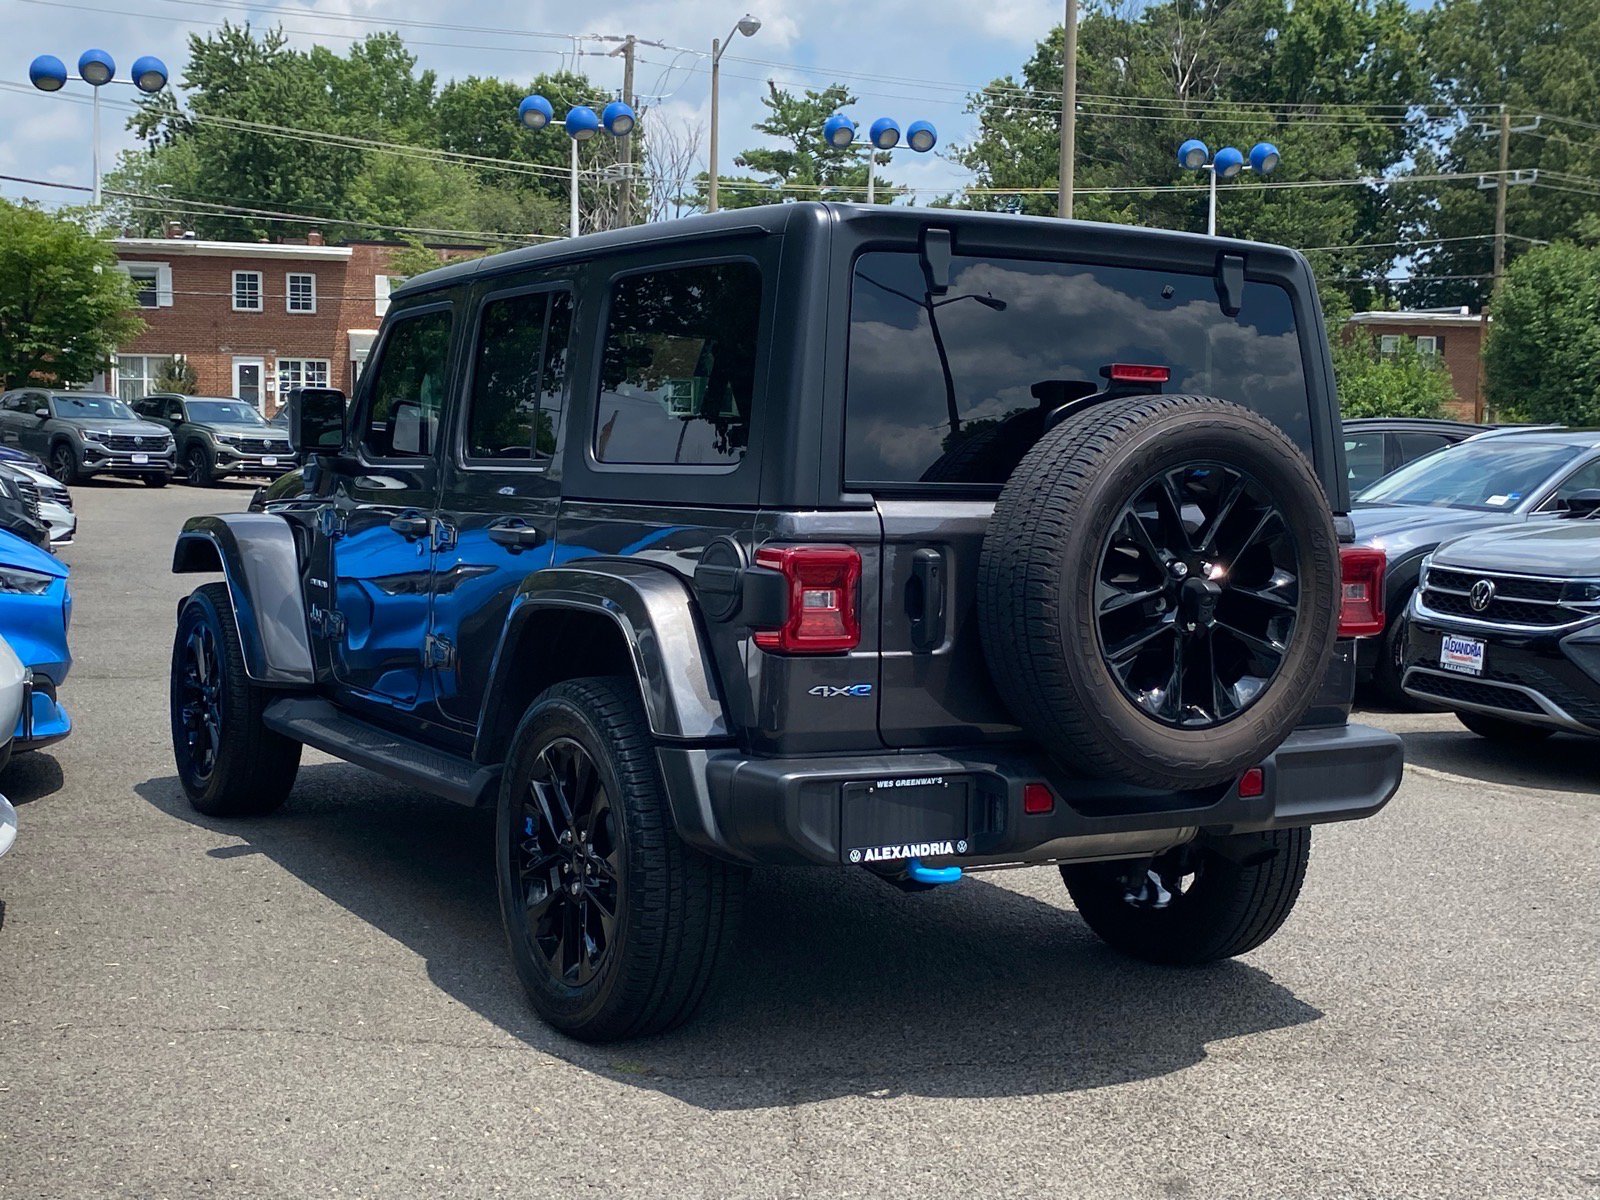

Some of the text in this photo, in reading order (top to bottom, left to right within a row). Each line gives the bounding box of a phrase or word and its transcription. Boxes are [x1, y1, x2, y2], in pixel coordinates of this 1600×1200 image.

[1444, 637, 1482, 658] ALEXANDRIA
[877, 777, 943, 788] WES GREENWAY'S
[864, 842, 954, 861] ALEXANDRIA
